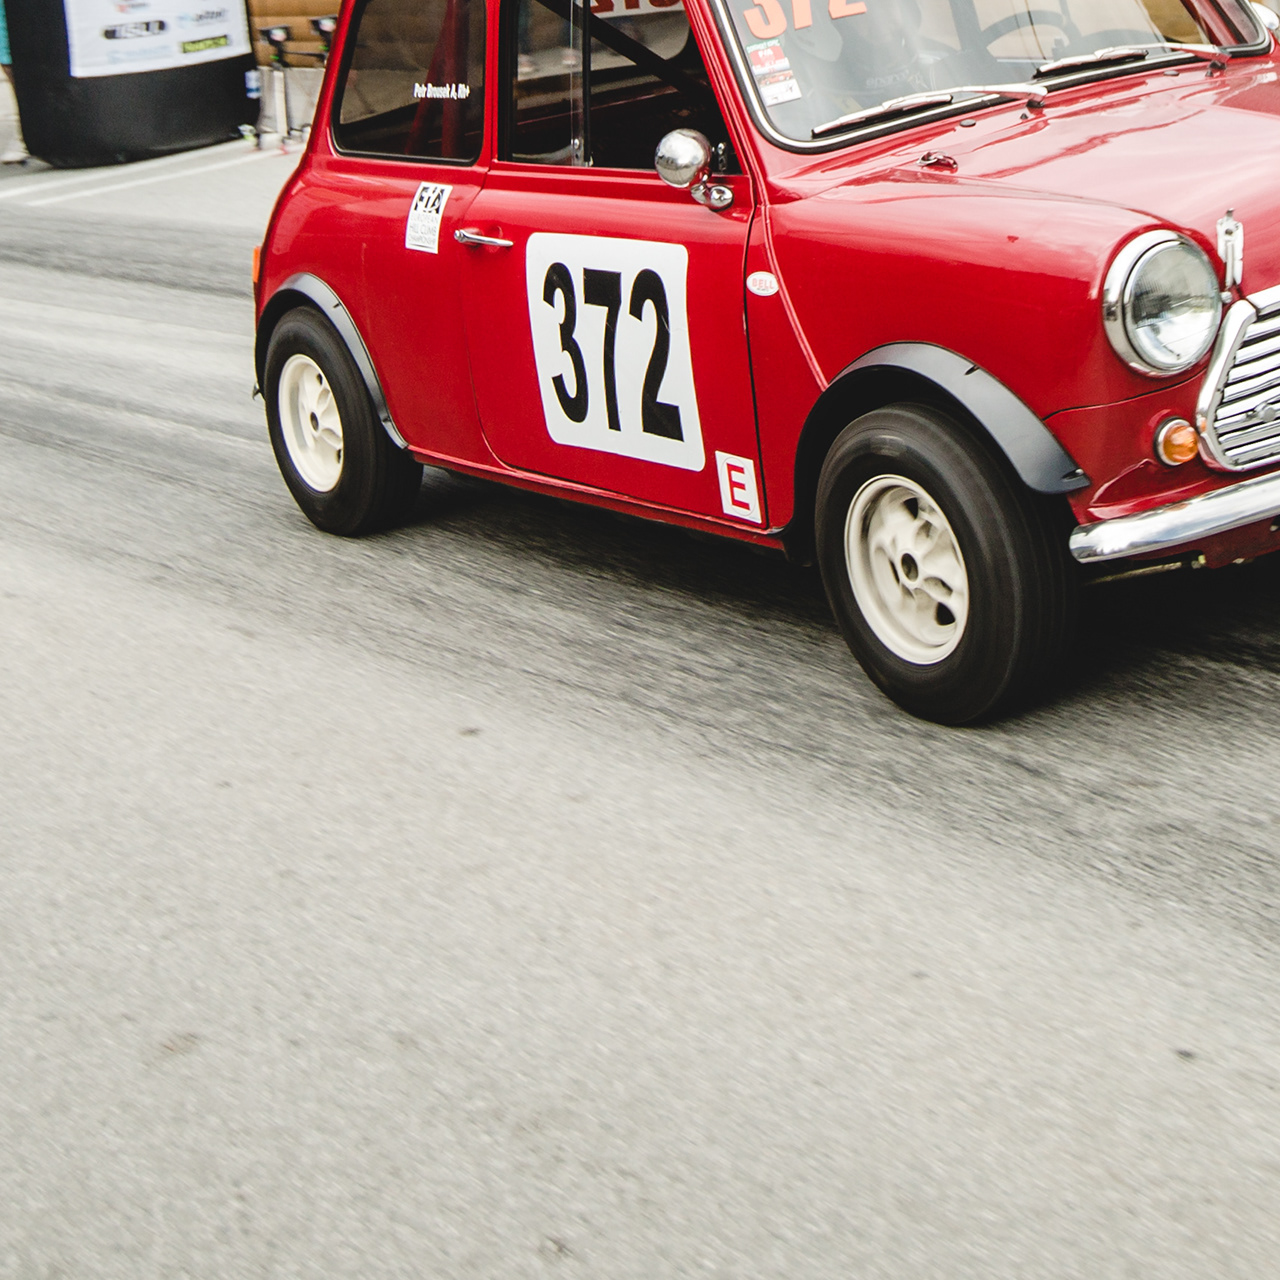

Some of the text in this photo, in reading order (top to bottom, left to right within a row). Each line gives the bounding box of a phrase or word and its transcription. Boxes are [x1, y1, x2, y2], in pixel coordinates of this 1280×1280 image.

[752, 278, 774, 290] BELL
[543, 262, 685, 442] 372
[728, 463, 750, 511] E
